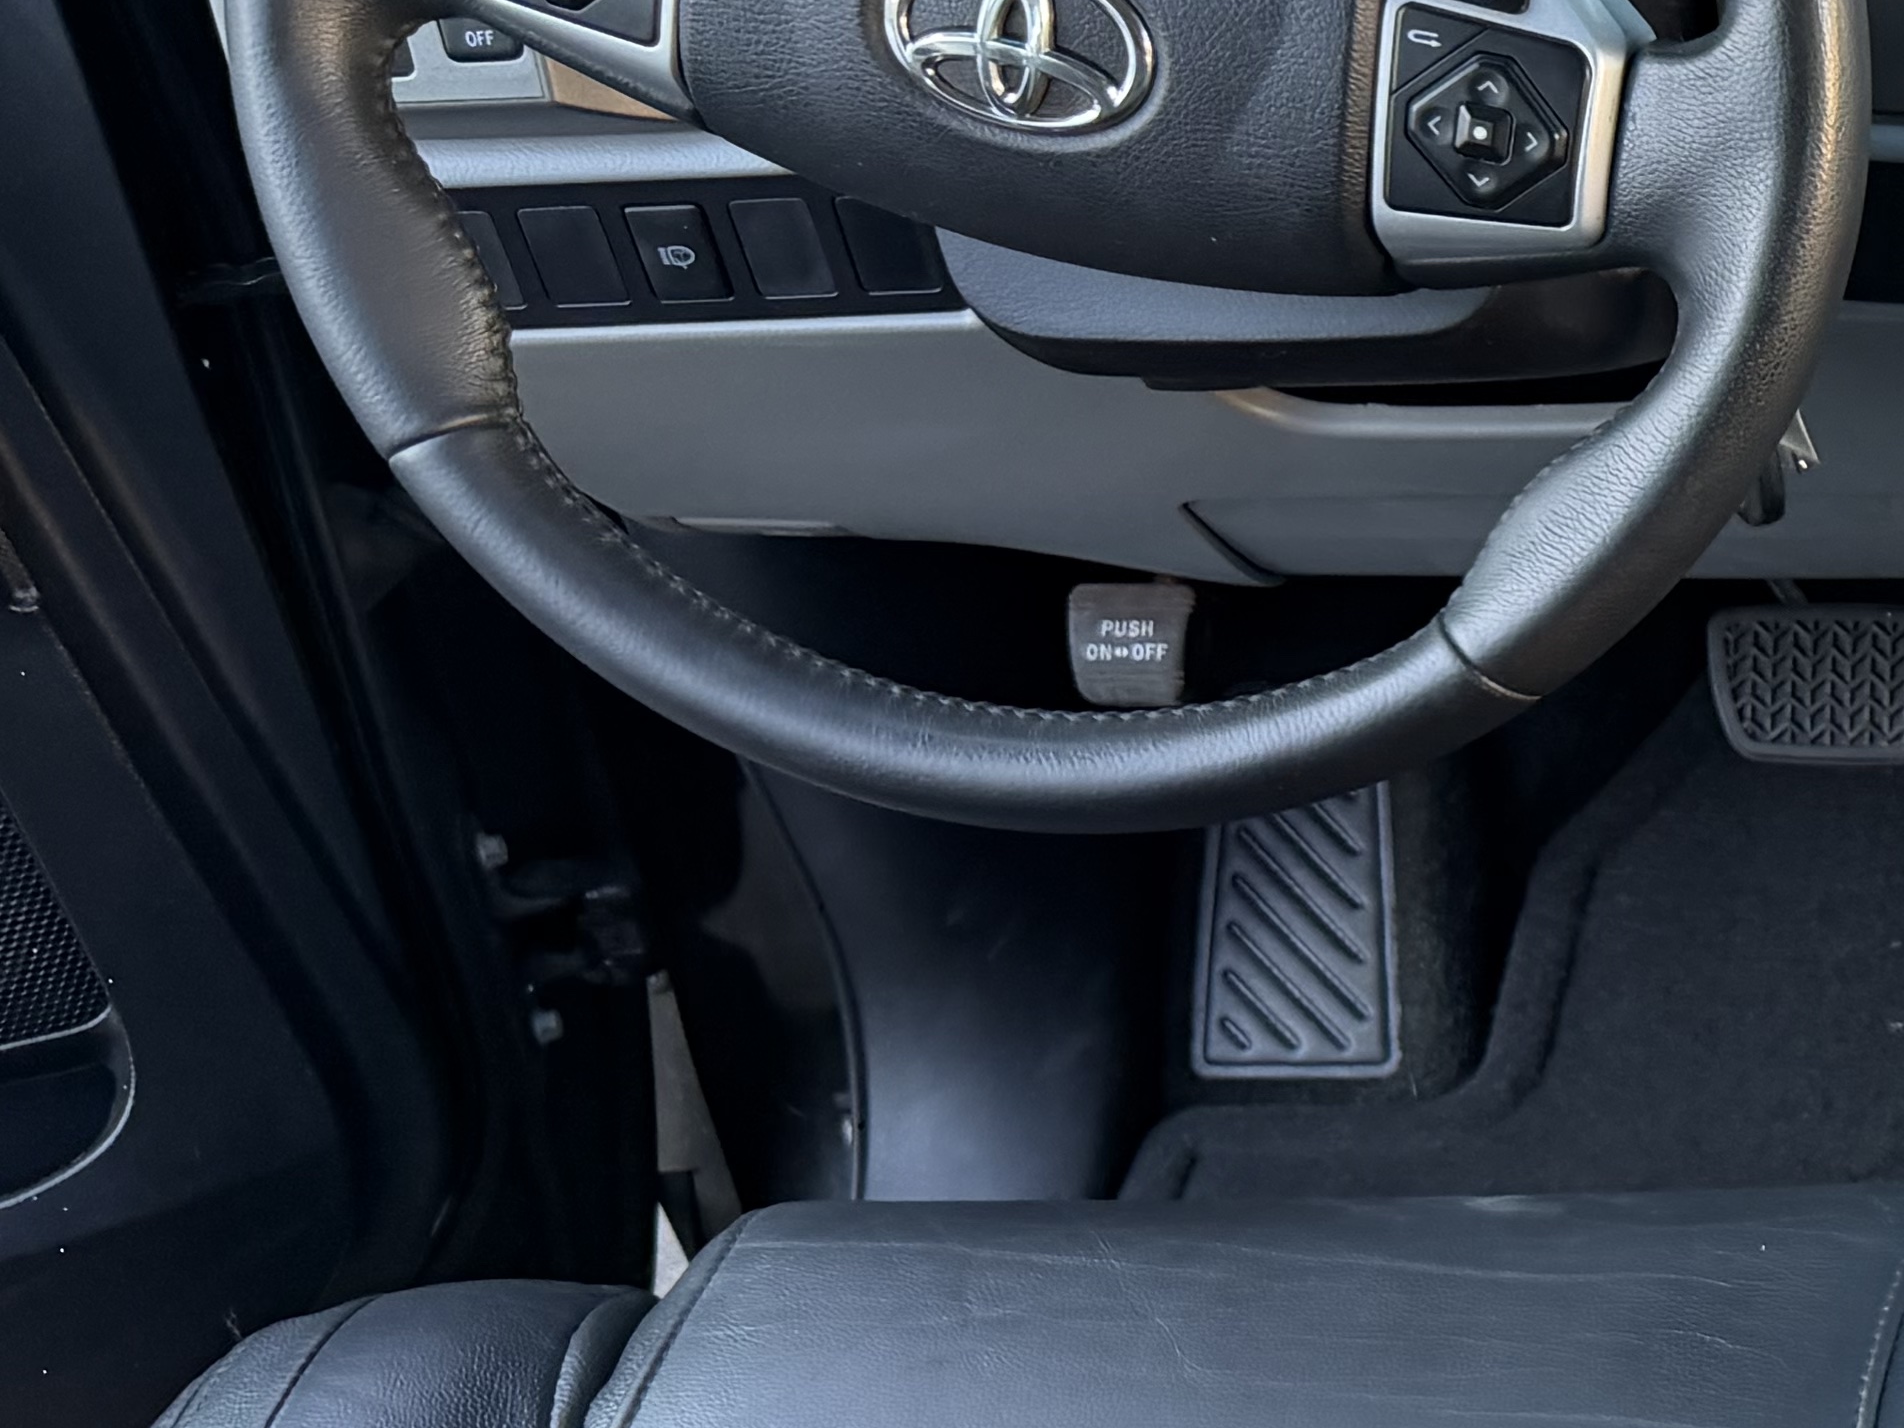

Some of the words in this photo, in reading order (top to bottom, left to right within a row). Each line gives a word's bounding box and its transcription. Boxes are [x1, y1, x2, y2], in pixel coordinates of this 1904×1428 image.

[464, 29, 495, 47] OFF
[1100, 619, 1154, 638] PUSH
[1085, 643, 1112, 662] ON
[1131, 643, 1169, 662] OFF
